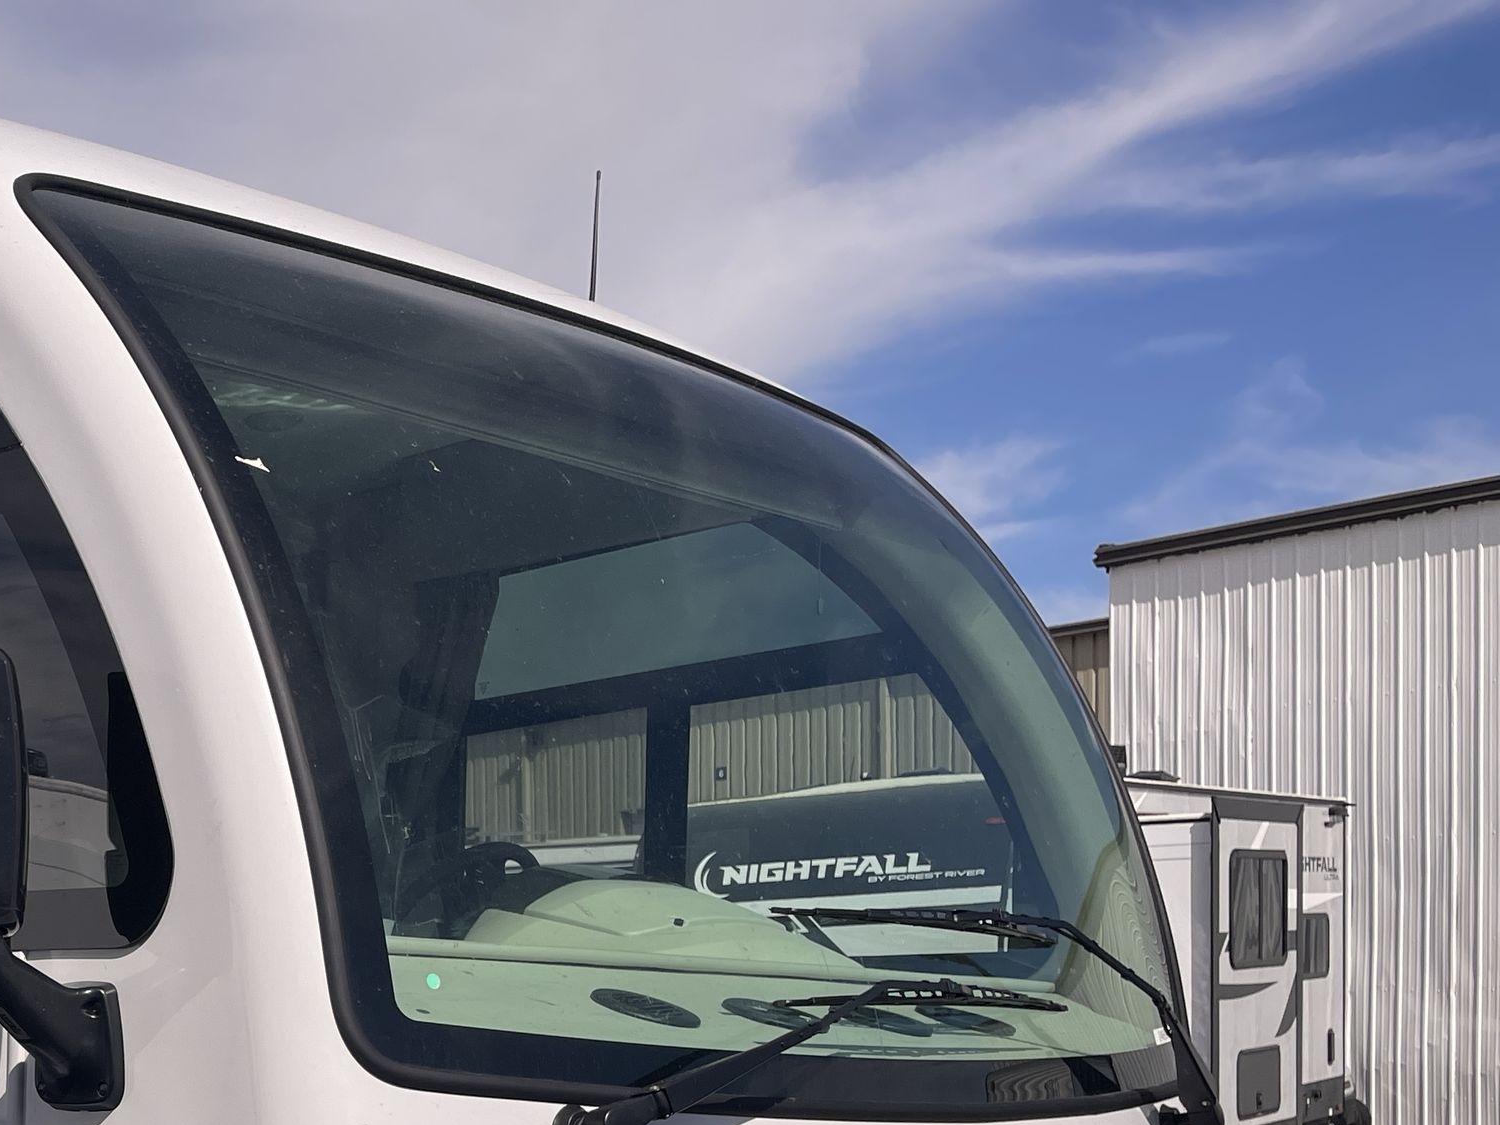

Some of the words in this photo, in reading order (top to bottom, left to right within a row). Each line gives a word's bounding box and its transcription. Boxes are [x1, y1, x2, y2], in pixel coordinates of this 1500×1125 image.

[719, 852, 932, 886] NIGHTFALL
[1302, 856, 1338, 873] HTFALL
[867, 874, 885, 883] BY
[888, 871, 942, 882] FOREST
[942, 868, 986, 879] RIVER
